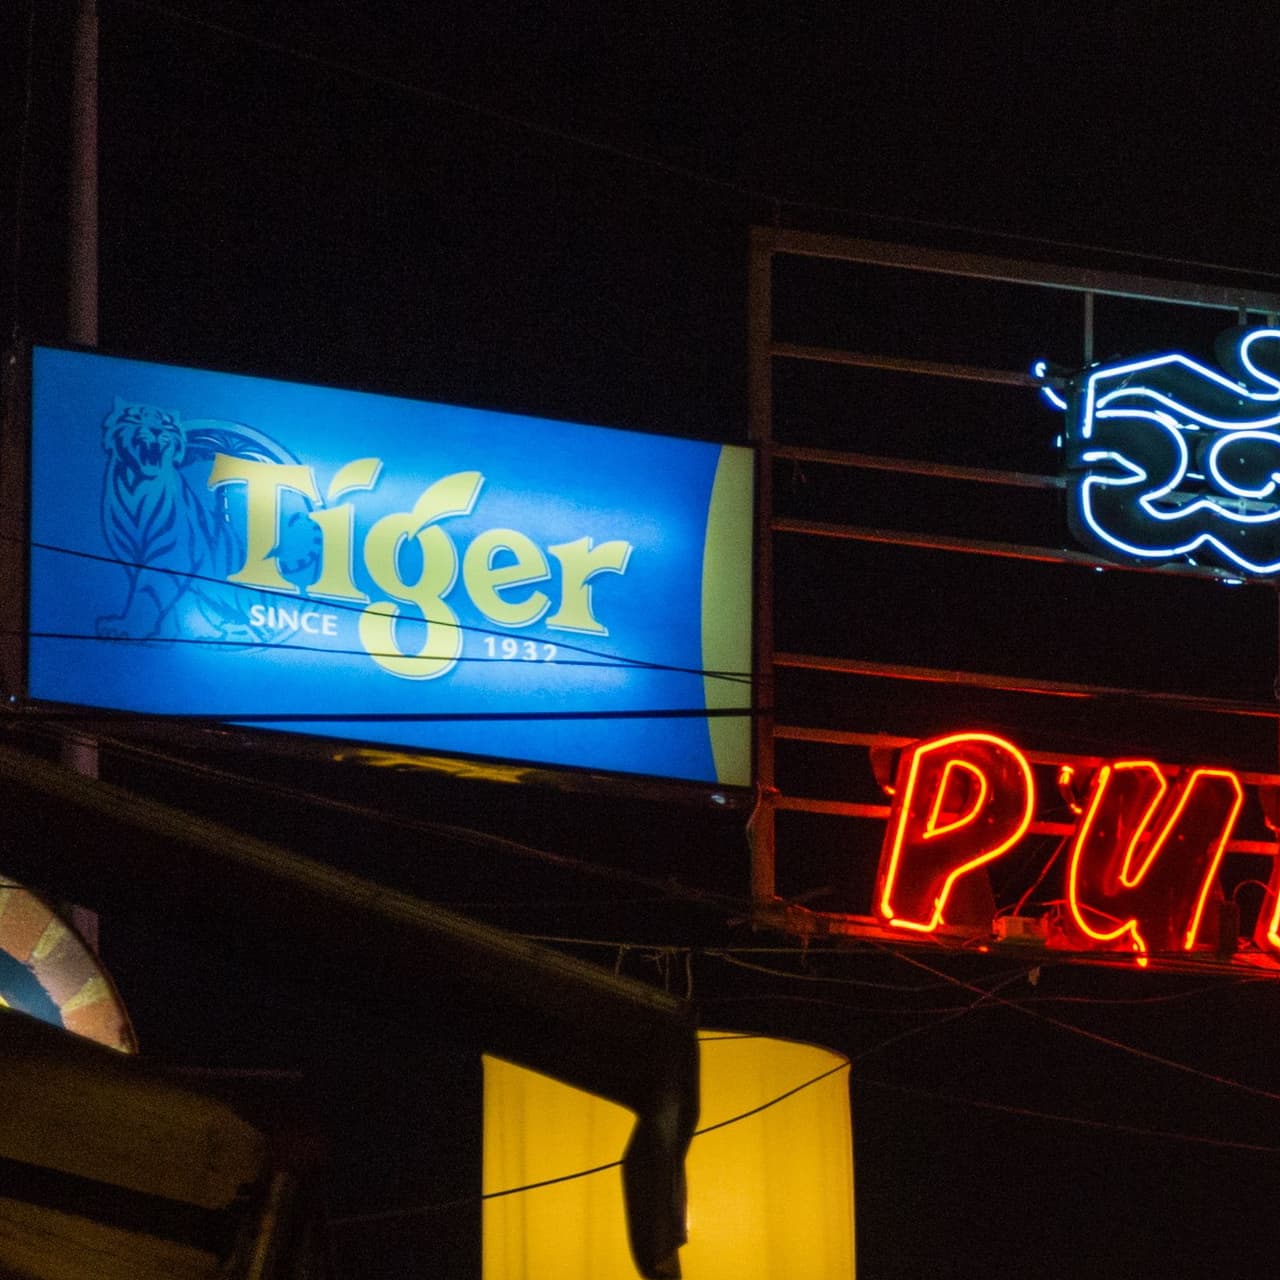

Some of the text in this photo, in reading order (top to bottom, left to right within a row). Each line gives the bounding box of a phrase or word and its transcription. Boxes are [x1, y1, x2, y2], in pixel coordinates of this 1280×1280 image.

[206, 453, 634, 680] Tiger
[249, 603, 558, 664] SINCE 1932
